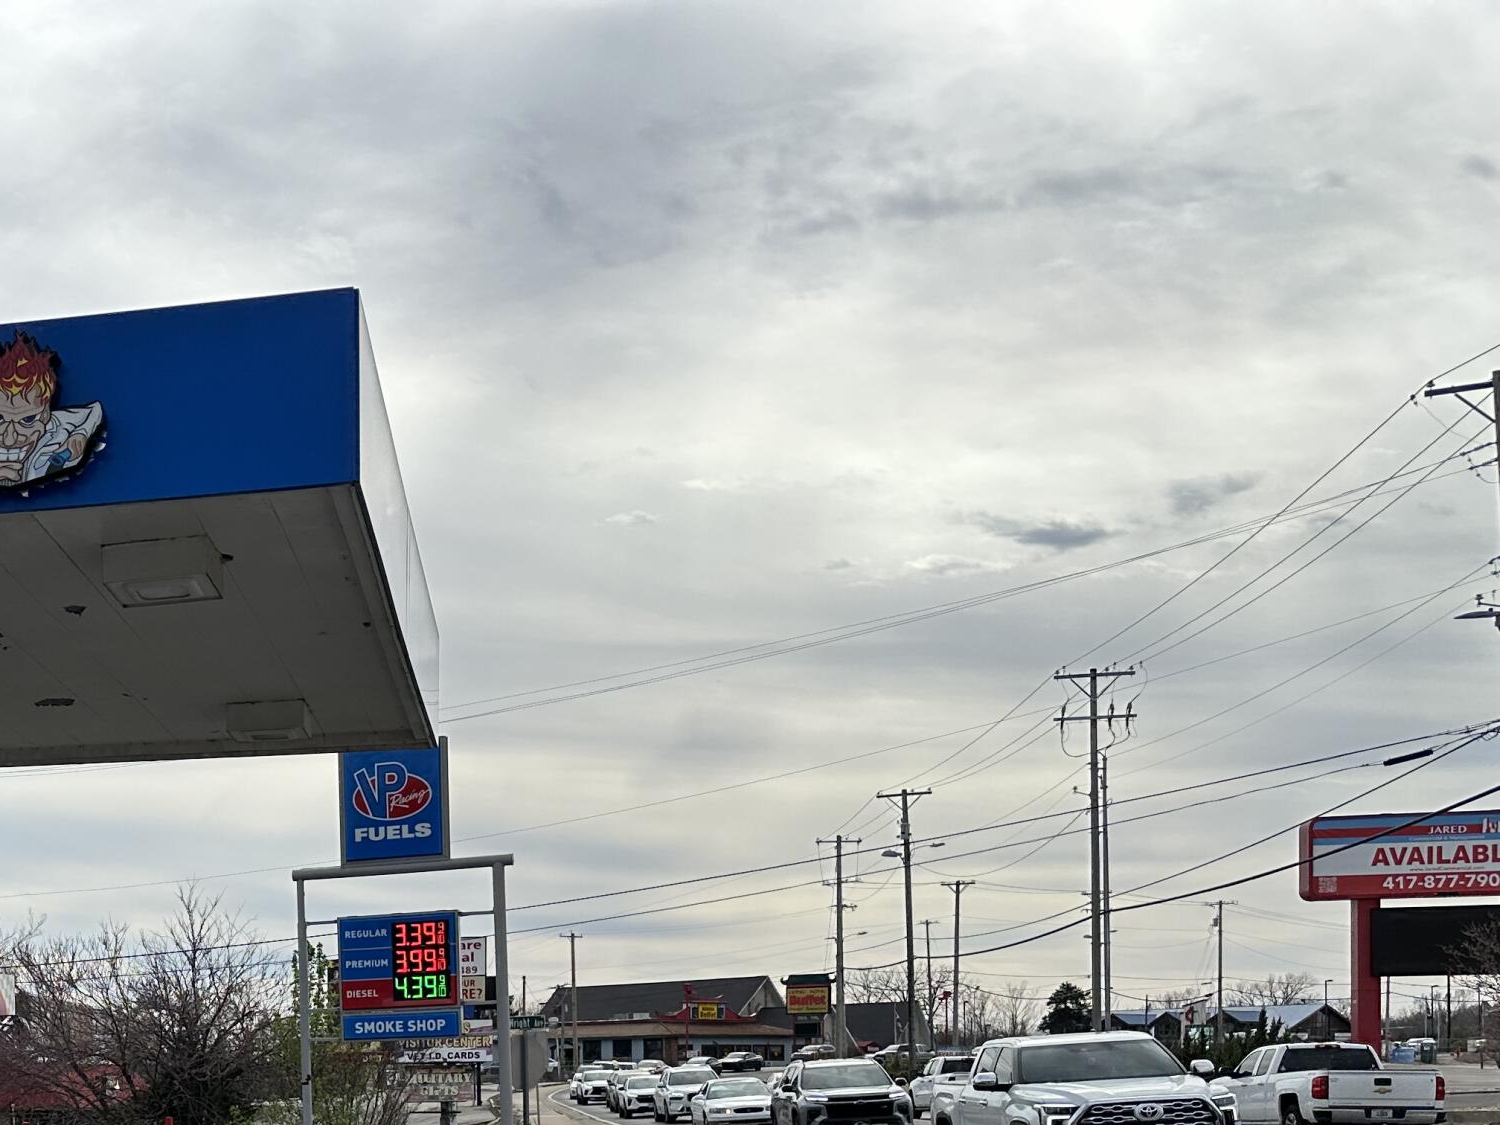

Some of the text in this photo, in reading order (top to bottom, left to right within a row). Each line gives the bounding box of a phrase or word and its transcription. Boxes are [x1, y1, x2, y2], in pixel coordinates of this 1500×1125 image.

[354, 762, 430, 820] VP Racing
[354, 822, 432, 843] FUELS
[1428, 825, 1467, 835] JARED
[1371, 843, 1500, 867] AVAILABL
[1382, 873, 1500, 890] 417-877-790
[344, 928, 388, 940] REGULAR
[395, 922, 436, 946] 3.39
[345, 958, 389, 969] PREMIUM
[396, 949, 437, 973] 3.99
[346, 989, 379, 998] DIESEL
[394, 975, 437, 999] 4.39
[355, 1019, 446, 1034] SMOKE SHOP
[445, 1036, 491, 1048] CENTER
[447, 1051, 481, 1060] CARDS
[419, 1085, 459, 1096] GIFTS
